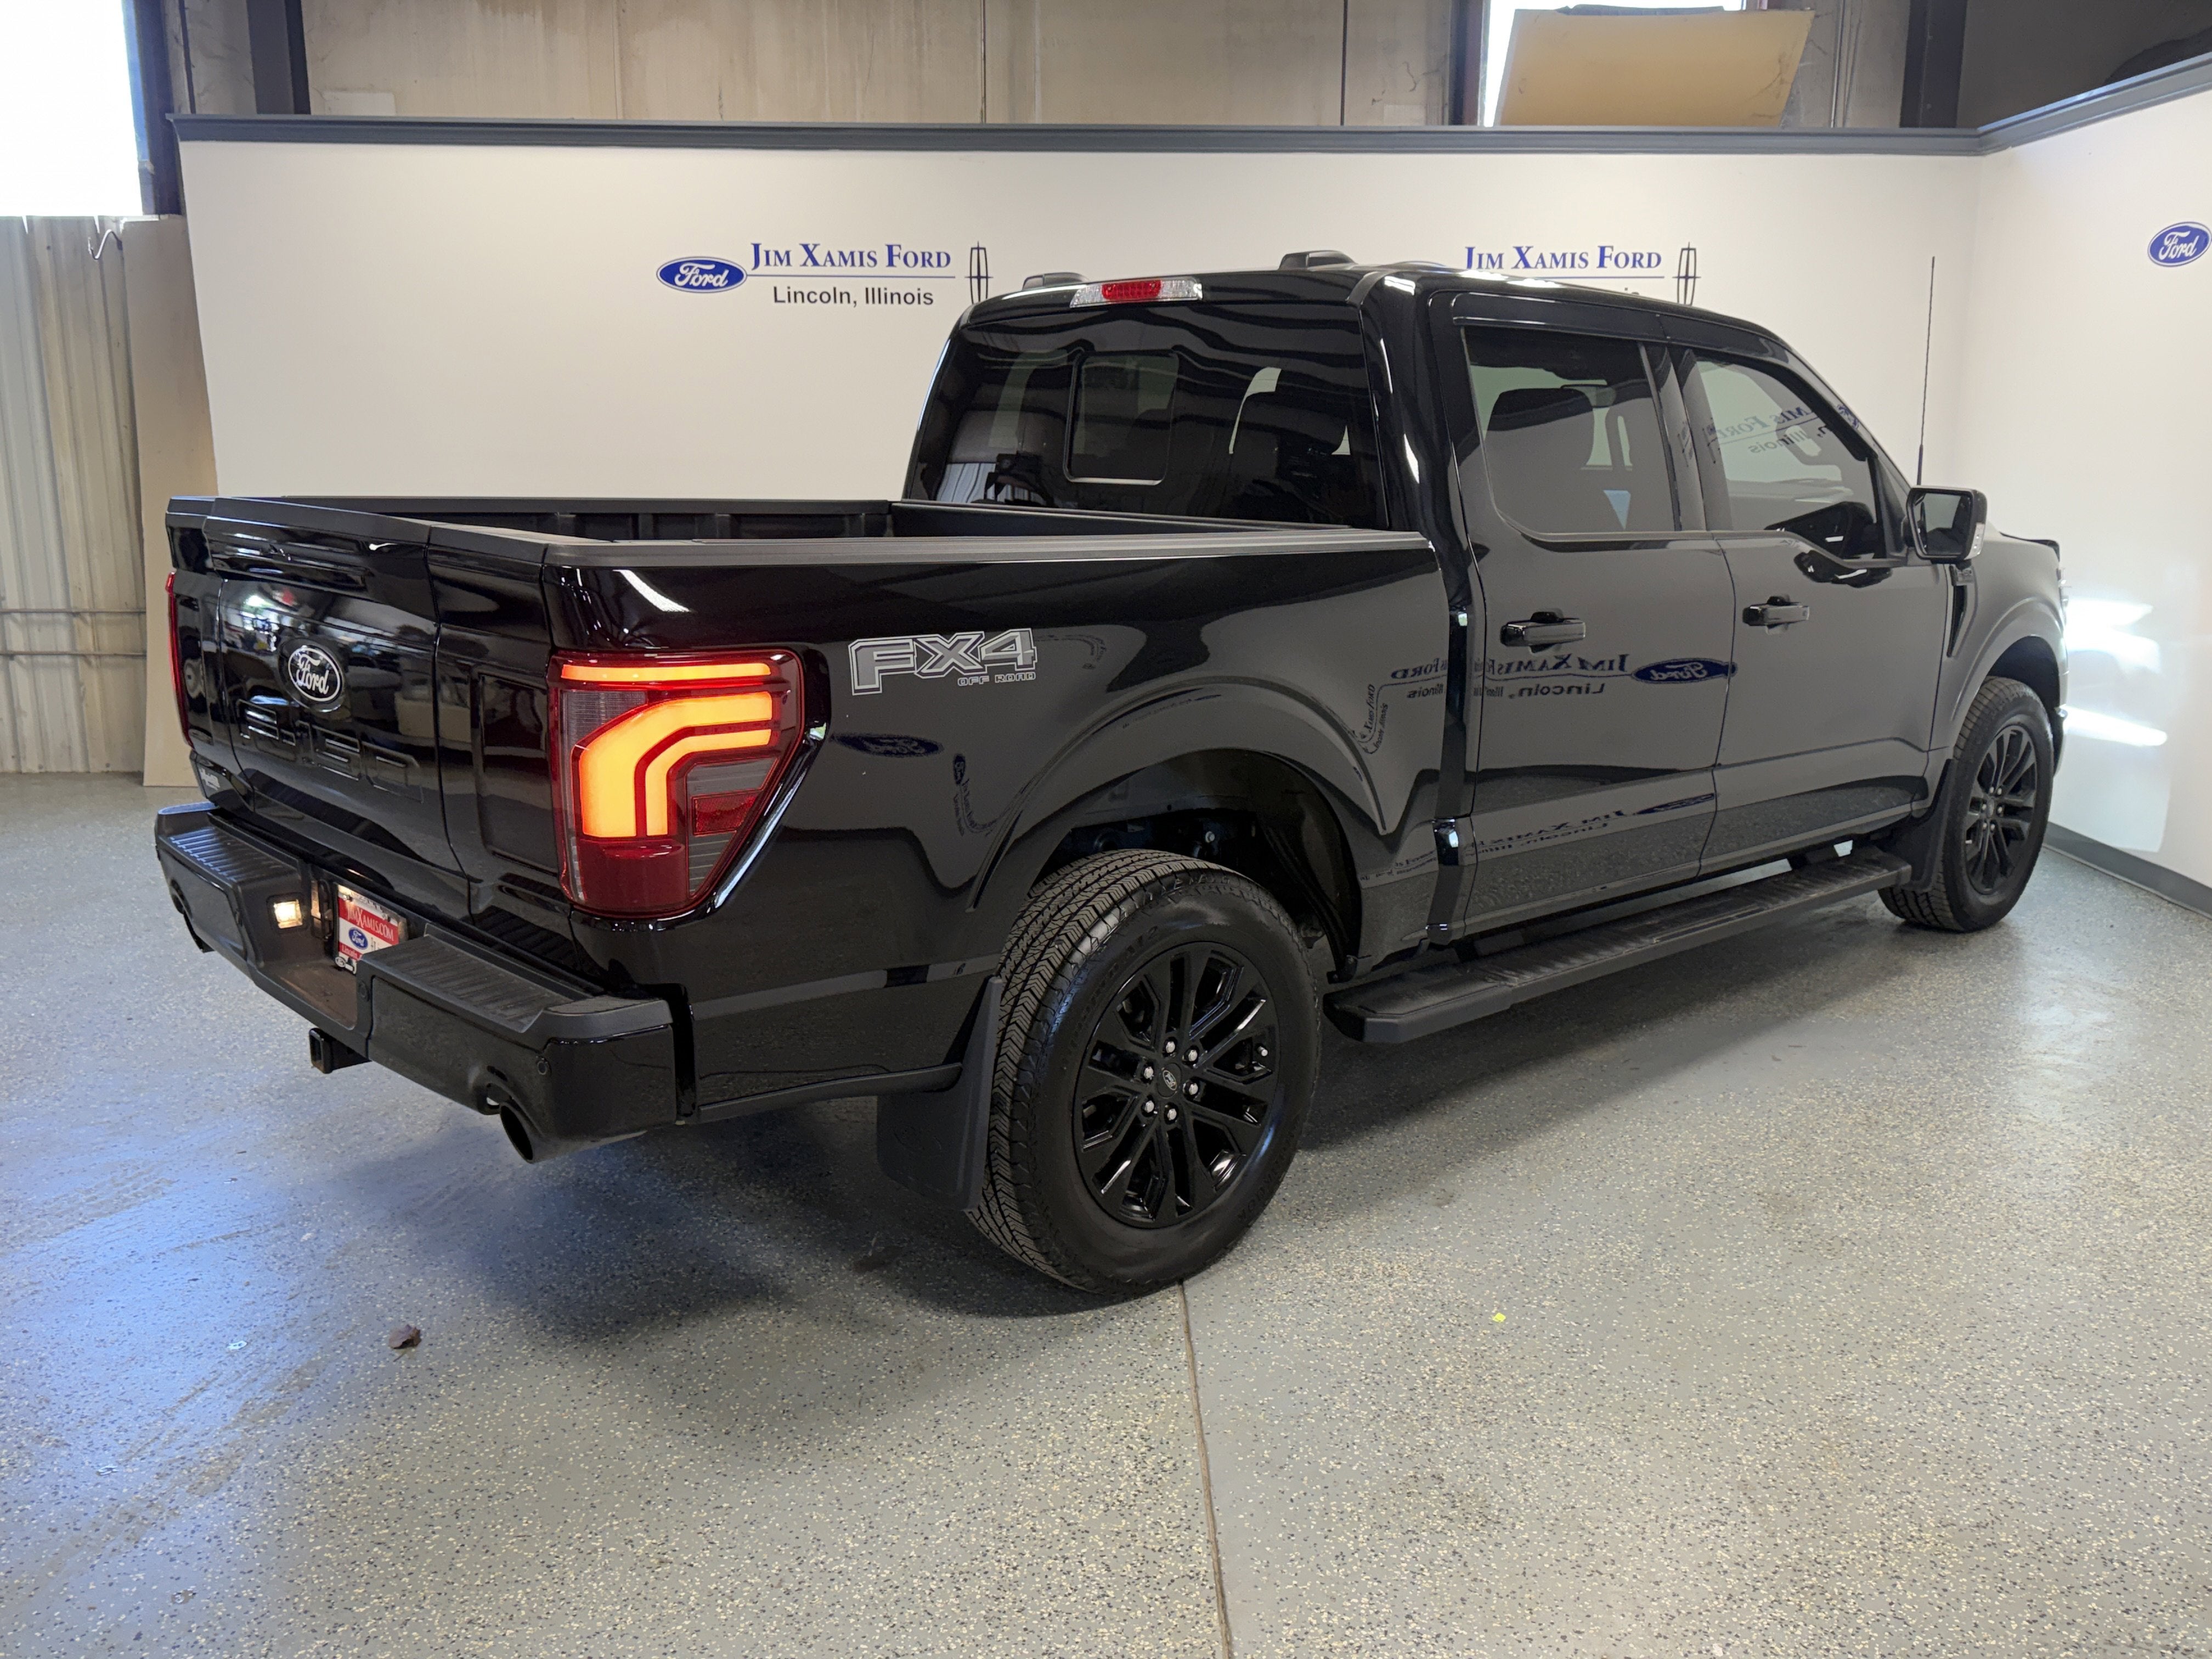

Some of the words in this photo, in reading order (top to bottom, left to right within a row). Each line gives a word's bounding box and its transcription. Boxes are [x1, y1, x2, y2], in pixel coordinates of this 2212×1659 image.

[751, 243, 791, 270] JIM
[799, 244, 877, 268] XAMIS
[885, 245, 951, 268] FORD
[1465, 246, 1504, 270] JIM
[1511, 245, 1589, 269] XAMIS
[1596, 245, 1662, 269] FORD
[2158, 230, 2200, 261] Ford
[674, 262, 729, 288] Ford
[773, 286, 856, 307] Lincoln,
[865, 287, 934, 305] Illinois
[296, 653, 330, 695] Ford
[848, 628, 1038, 695] FX4
[957, 675, 990, 686] OFF
[995, 672, 1036, 683] ROAD
